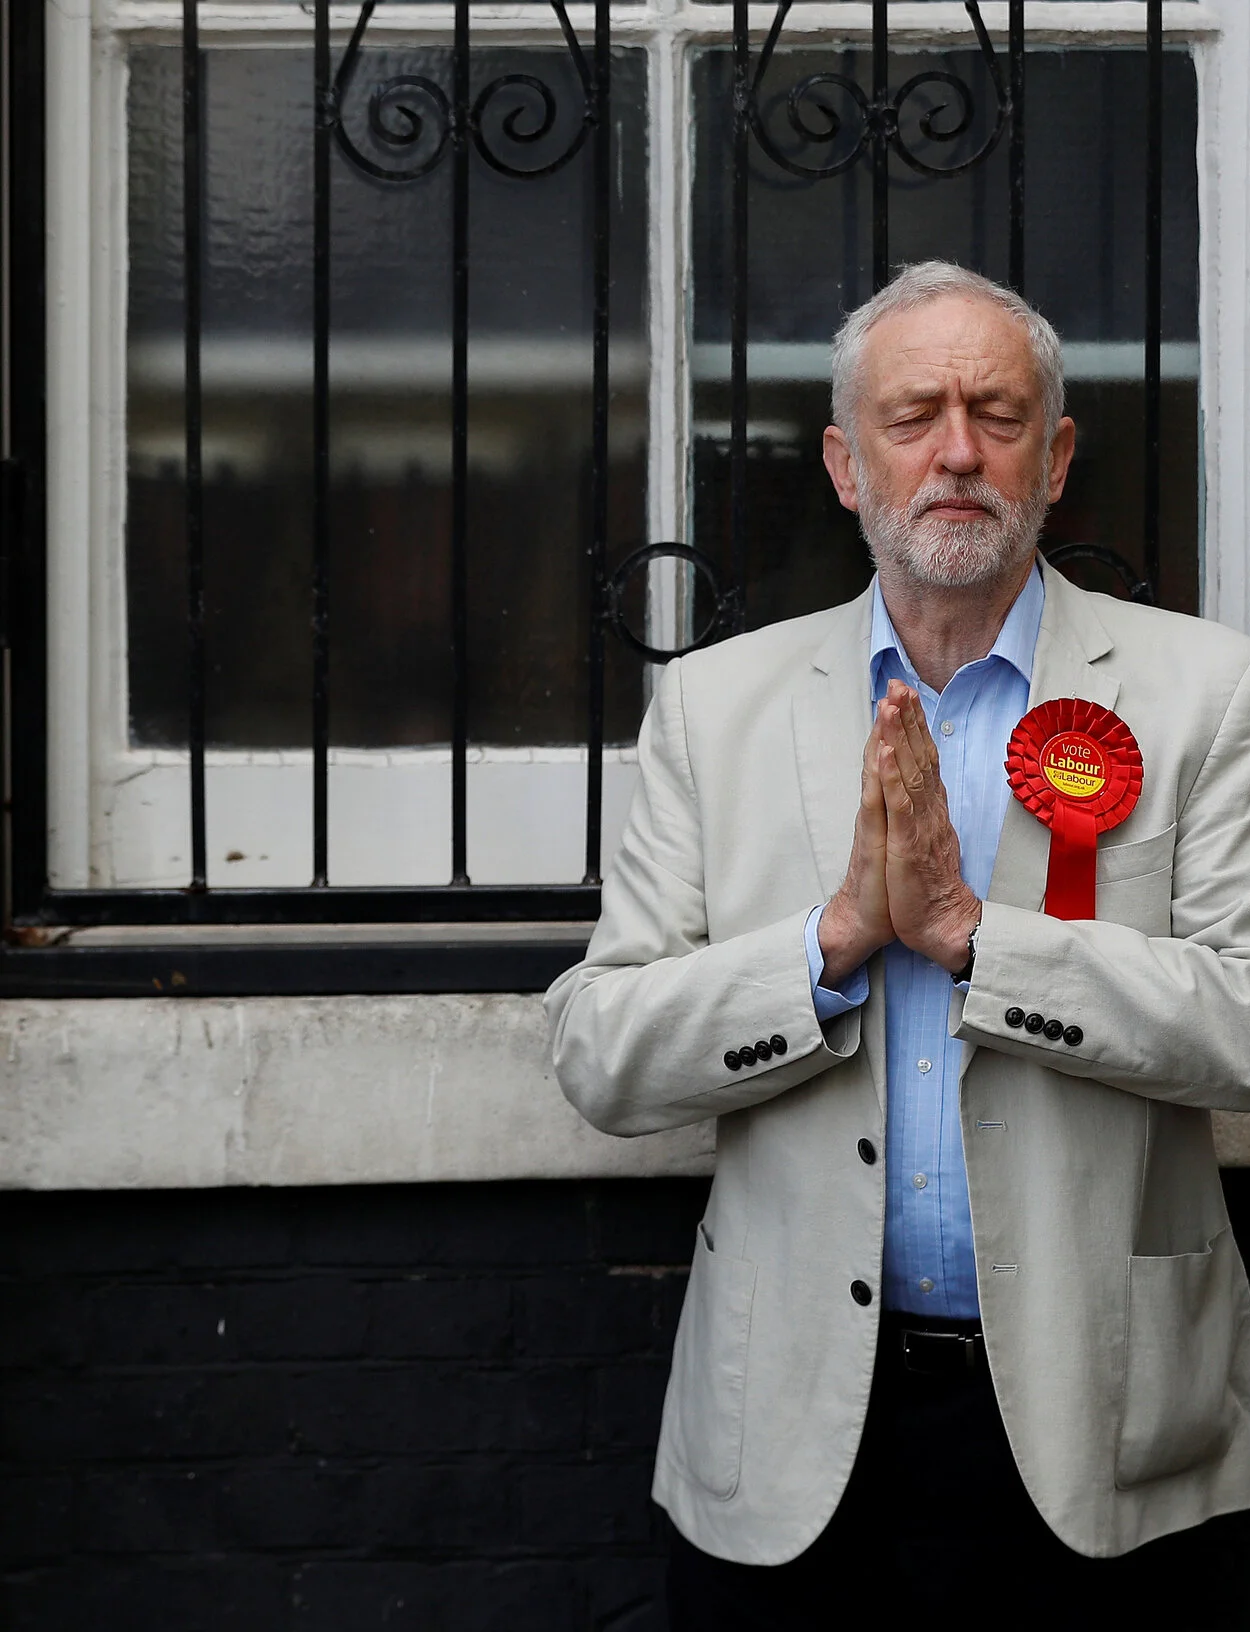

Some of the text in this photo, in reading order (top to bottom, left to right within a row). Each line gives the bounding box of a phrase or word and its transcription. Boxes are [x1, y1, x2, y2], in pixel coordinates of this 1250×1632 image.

[1062, 743, 1091, 759] vote
[1050, 753, 1101, 775] Labour
[1062, 772, 1096, 787] Labour
